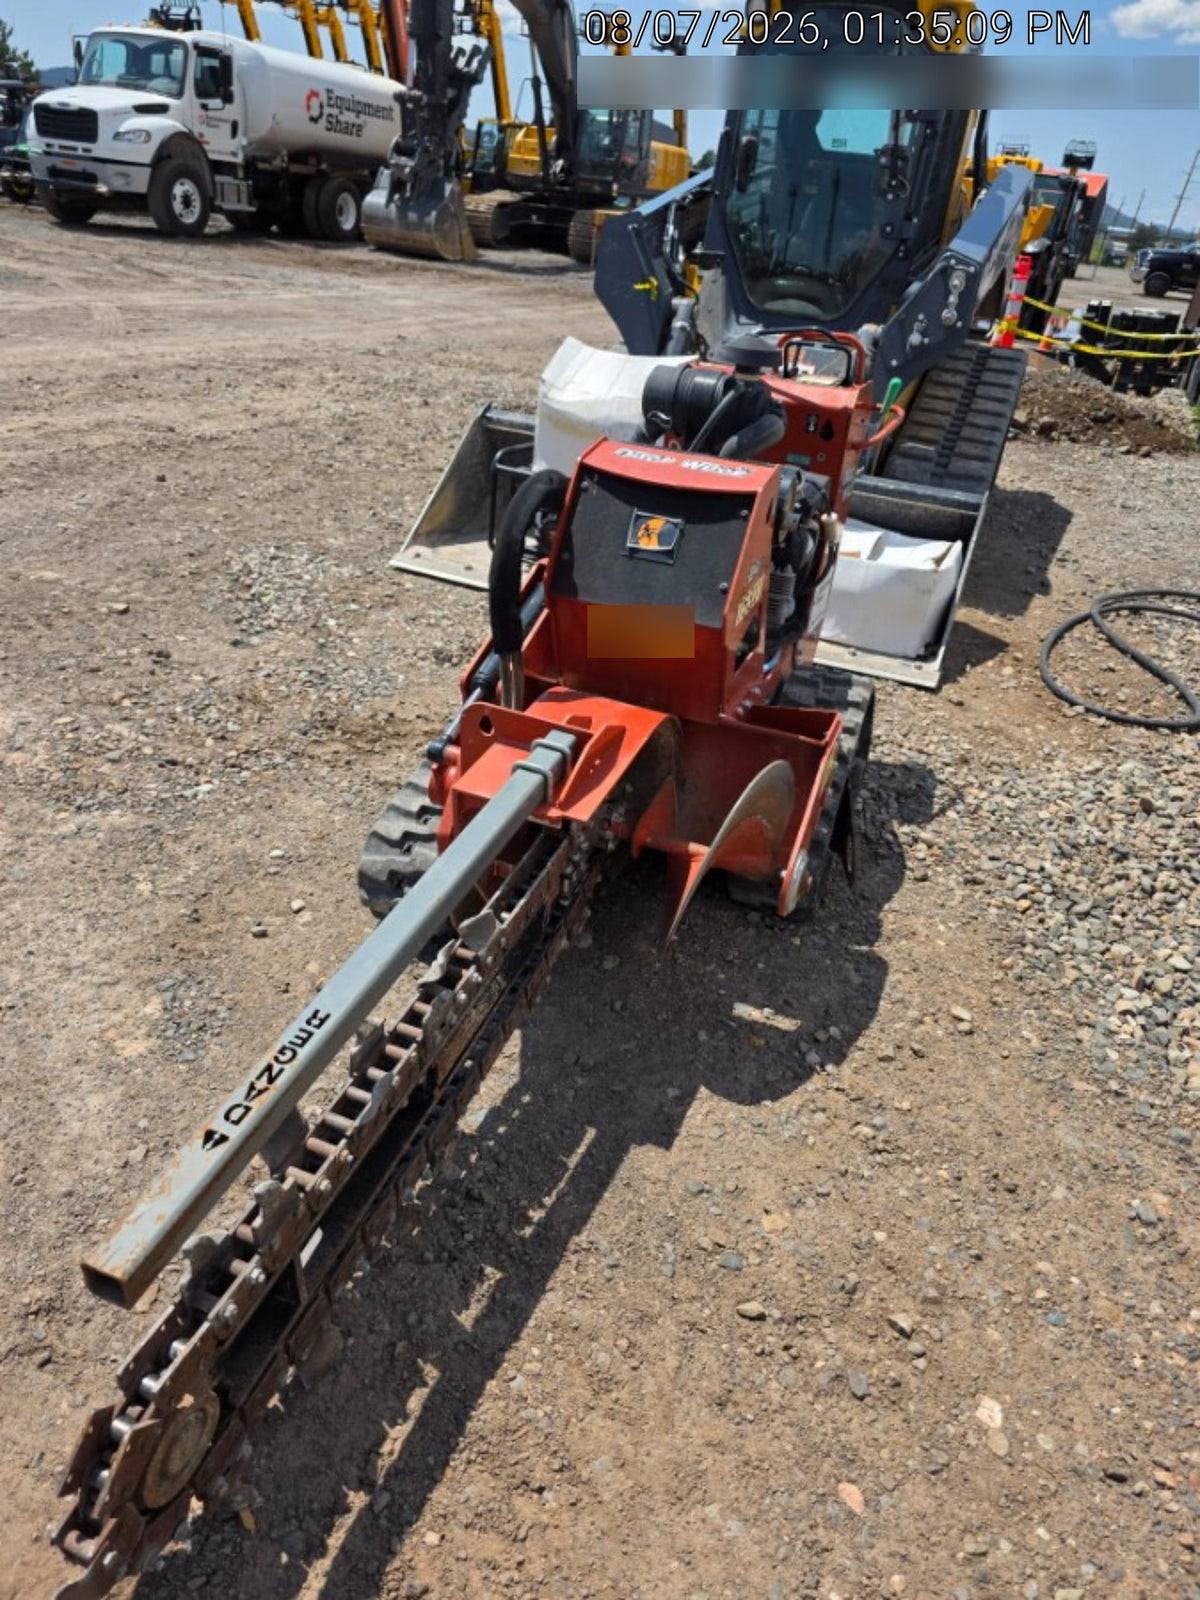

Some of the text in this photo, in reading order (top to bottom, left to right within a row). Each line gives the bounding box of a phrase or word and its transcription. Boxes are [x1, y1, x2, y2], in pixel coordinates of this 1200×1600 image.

[325, 87, 394, 122] Equipment
[324, 113, 364, 138] Share
[223, 1008, 332, 1126] DANGER
